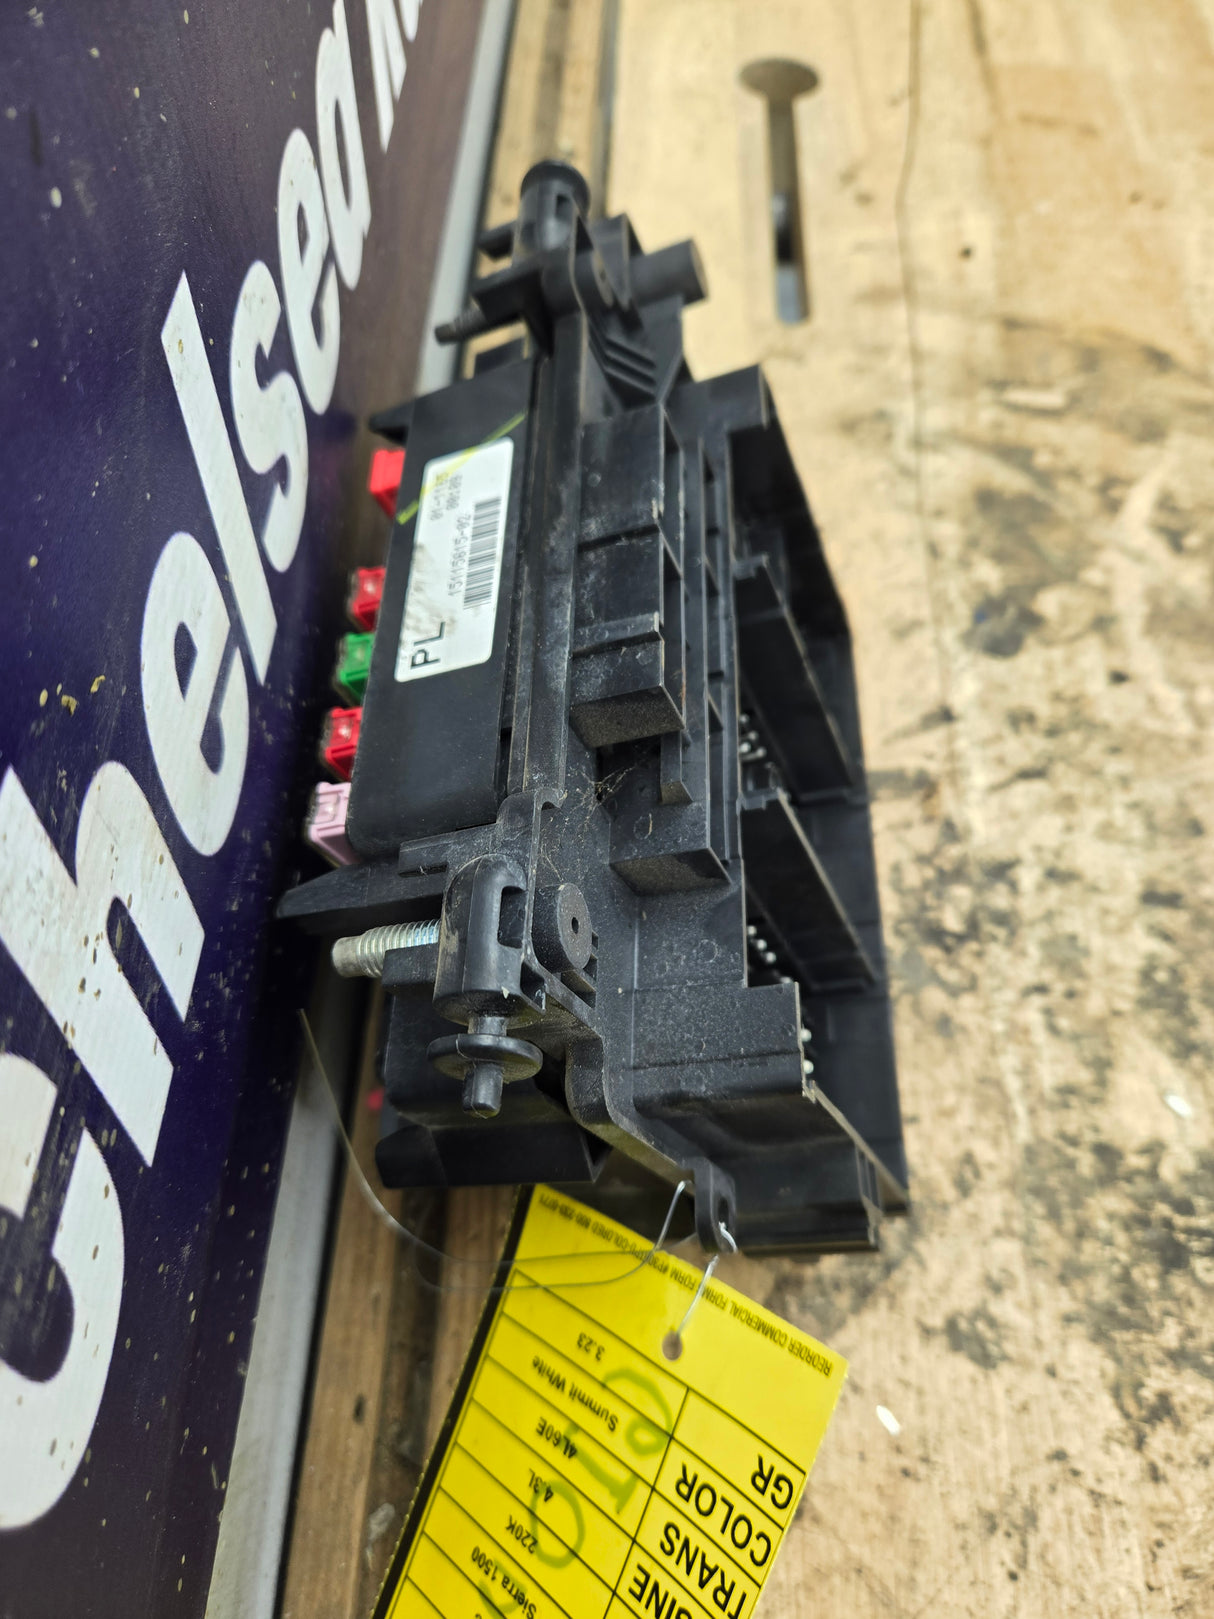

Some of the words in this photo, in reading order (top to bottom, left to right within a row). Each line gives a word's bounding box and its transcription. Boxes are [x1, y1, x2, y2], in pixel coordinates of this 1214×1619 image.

[410, 621, 446, 670] PL
[669, 1266, 697, 1291] FORM
[729, 1300, 788, 1348] COMMERCIAL
[577, 1331, 605, 1361] 3.23
[788, 1337, 834, 1377] REORDER
[532, 1355, 567, 1393] White
[568, 1382, 619, 1432] Summit
[535, 1416, 578, 1459] 4L60E
[528, 1468, 554, 1503] 4.3L
[750, 1454, 794, 1510] GR
[505, 1515, 538, 1554] 220K
[675, 1462, 772, 1567] COLOR
[471, 1545, 498, 1581] 1500
[660, 1521, 747, 1619] TRANS
[500, 1575, 537, 1619] Sierra
